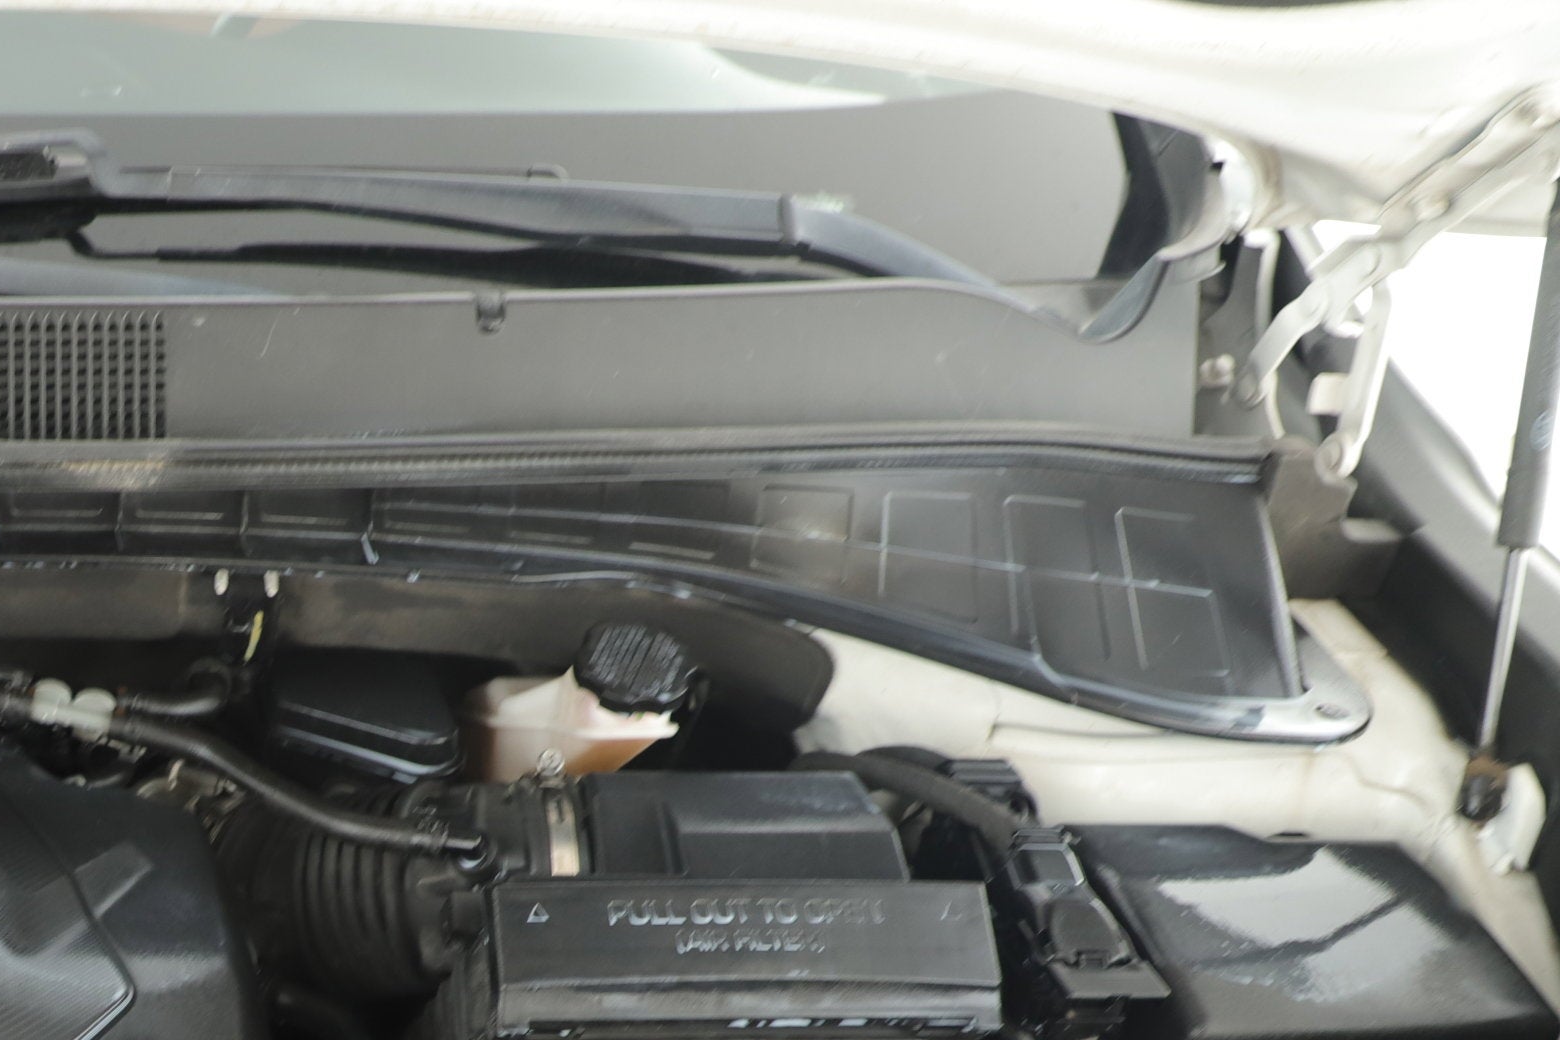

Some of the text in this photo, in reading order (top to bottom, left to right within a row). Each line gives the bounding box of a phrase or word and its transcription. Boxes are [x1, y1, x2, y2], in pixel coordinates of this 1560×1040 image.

[607, 899, 687, 927] PULL
[690, 898, 750, 925] OUT
[755, 898, 798, 925] TO
